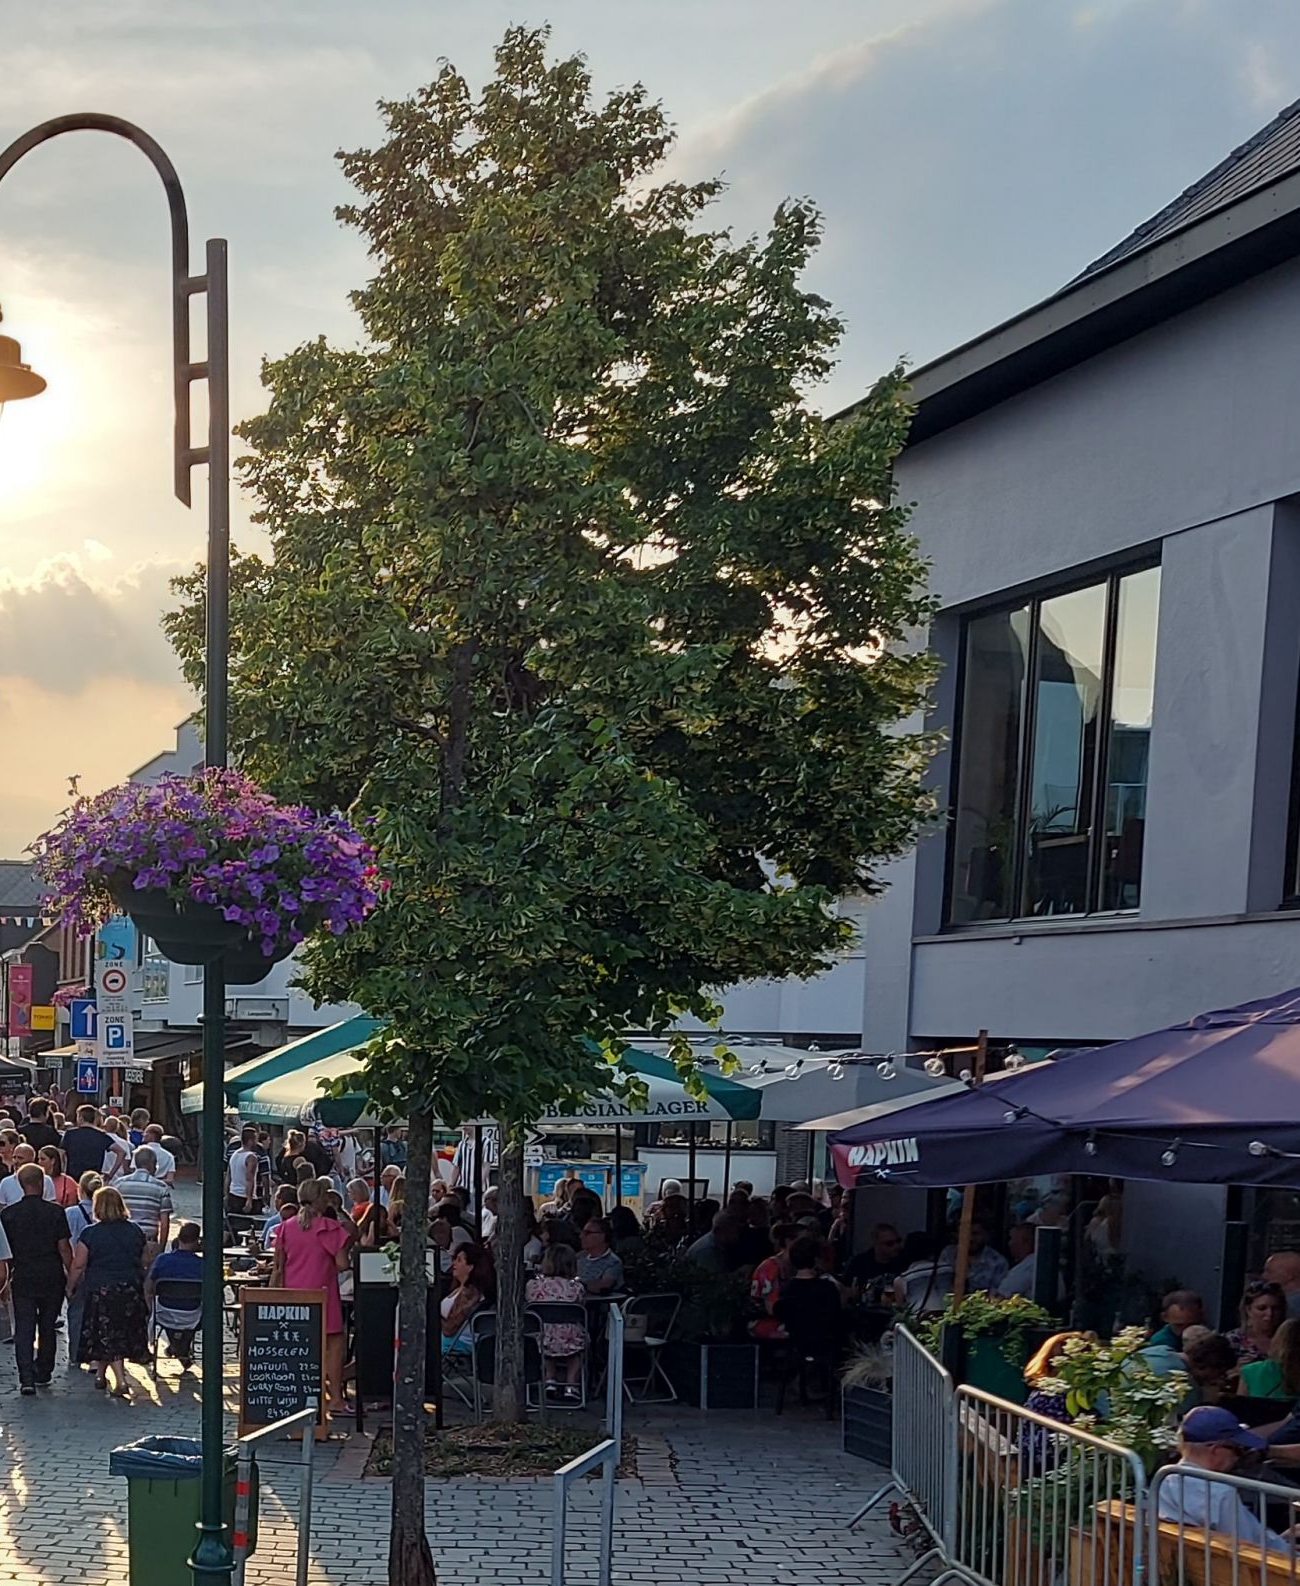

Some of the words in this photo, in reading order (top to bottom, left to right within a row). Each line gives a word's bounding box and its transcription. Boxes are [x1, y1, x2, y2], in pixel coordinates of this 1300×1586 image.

[108, 1027, 121, 1046] P
[546, 1102, 634, 1118] BLGIAN
[643, 1101, 710, 1116] LAGER
[848, 1137, 919, 1167] HAPKIN
[258, 1305, 310, 1320] HAPKIN
[249, 1362, 288, 1371] NATUUR
